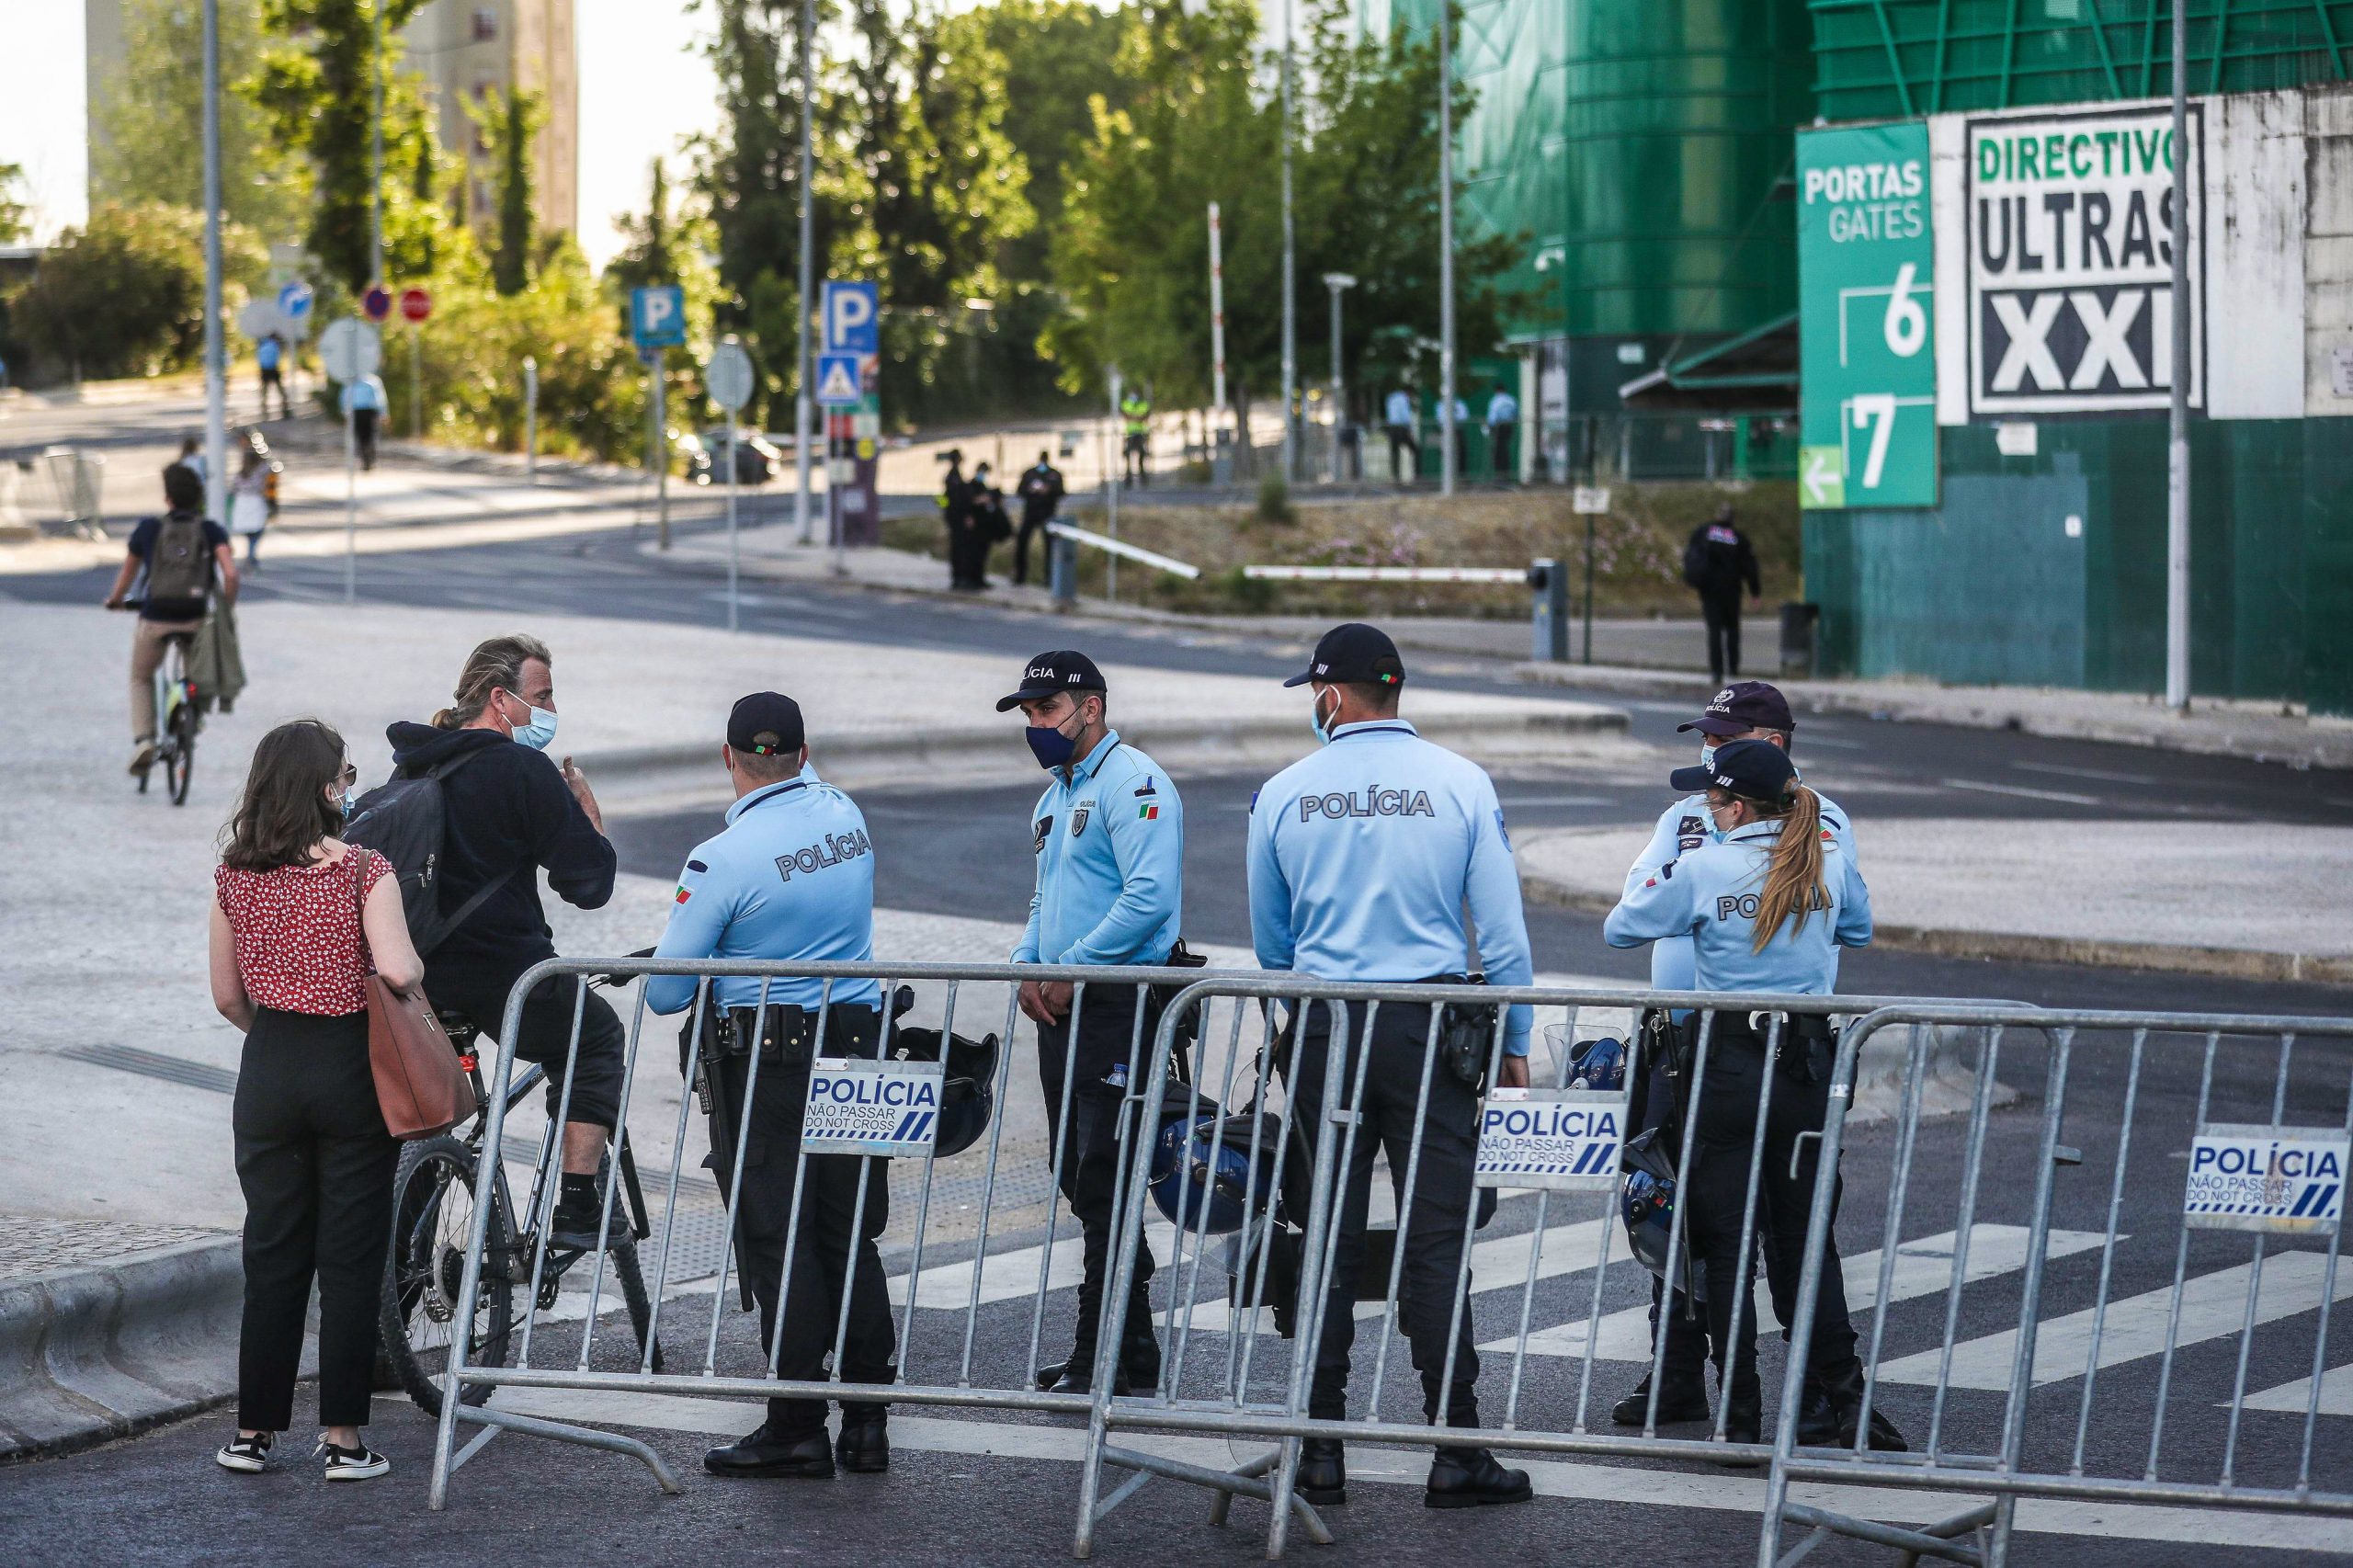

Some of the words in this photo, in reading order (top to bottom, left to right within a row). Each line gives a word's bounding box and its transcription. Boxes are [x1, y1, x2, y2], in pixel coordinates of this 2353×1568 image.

[1804, 159, 1923, 205] PORTAS
[1828, 200, 1924, 243] GATES
[645, 291, 673, 331] P
[833, 290, 870, 346] P
[1883, 262, 1927, 358] 6
[1852, 392, 1896, 489] 7
[1022, 665, 1055, 680] LÍCIA
[1300, 784, 1436, 823] POLÍCIA
[774, 828, 871, 882] POLÍCIA
[810, 1074, 936, 1107] POLÍCIA
[805, 1117, 823, 1128] DO
[825, 1118, 850, 1129] NOT
[853, 1119, 895, 1131] CROSS
[807, 1103, 836, 1118] NÃO
[840, 1106, 895, 1120] PASSAR
[1483, 1104, 1618, 1138] POLÍCIA
[1478, 1151, 1496, 1162] DO
[1499, 1151, 1527, 1162] NOT
[1529, 1152, 1574, 1164] CROSS
[1480, 1136, 1511, 1150] NÃO
[1515, 1139, 1574, 1152] PASSAR
[2192, 1142, 2339, 1178] POLÍCIA
[2187, 1189, 2207, 1200] DO
[2211, 1190, 2240, 1201] NOT
[2243, 1192, 2292, 1205] CROSS
[2188, 1174, 2222, 1189] NÃO
[2227, 1176, 2292, 1193] PASSAR
